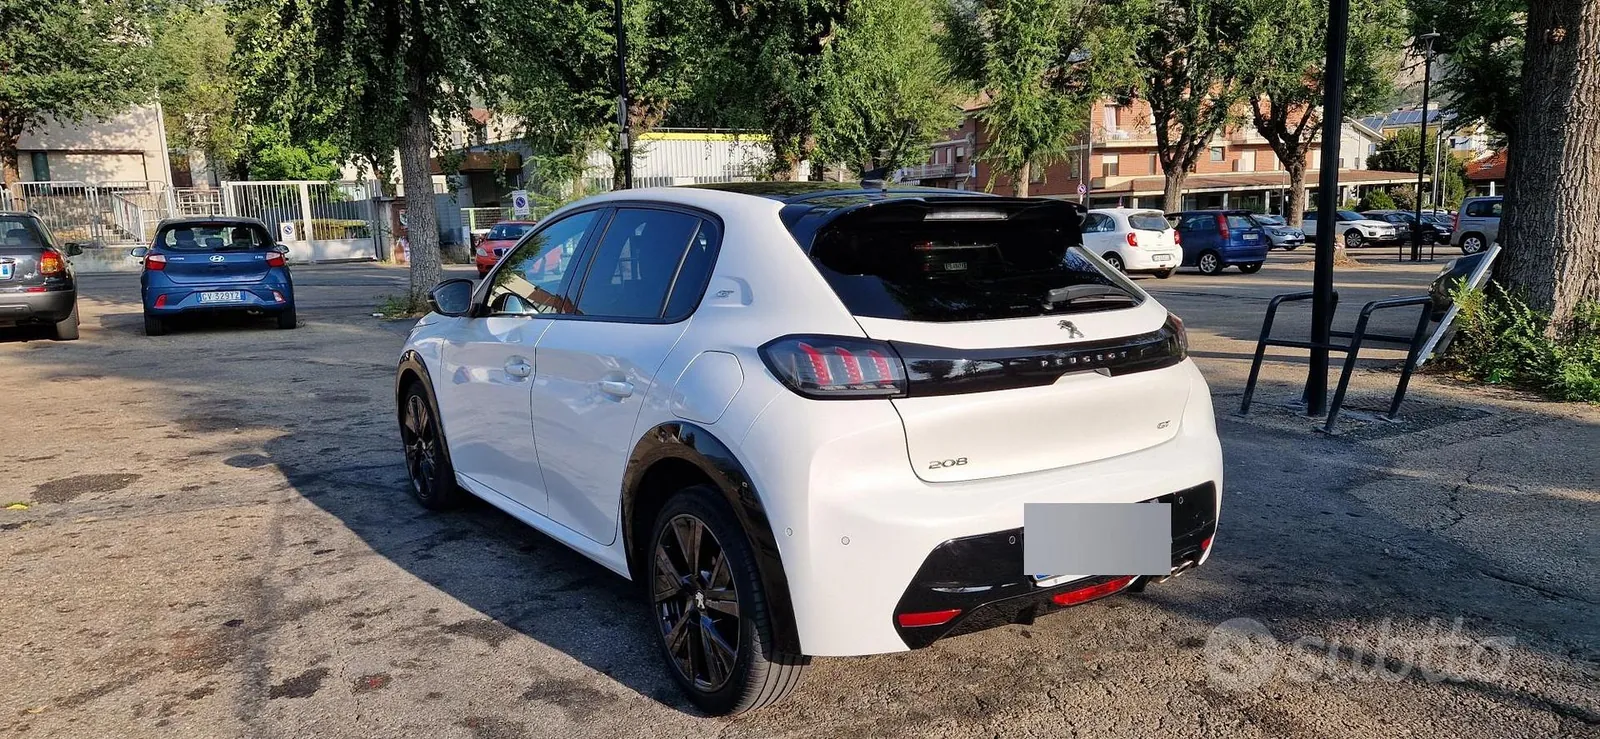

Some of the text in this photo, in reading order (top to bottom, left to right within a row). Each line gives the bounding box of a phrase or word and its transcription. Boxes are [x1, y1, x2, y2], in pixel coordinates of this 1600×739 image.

[1040, 351, 1128, 367] PEUGEOT
[1156, 419, 1171, 429] GT
[928, 457, 968, 470] 208
